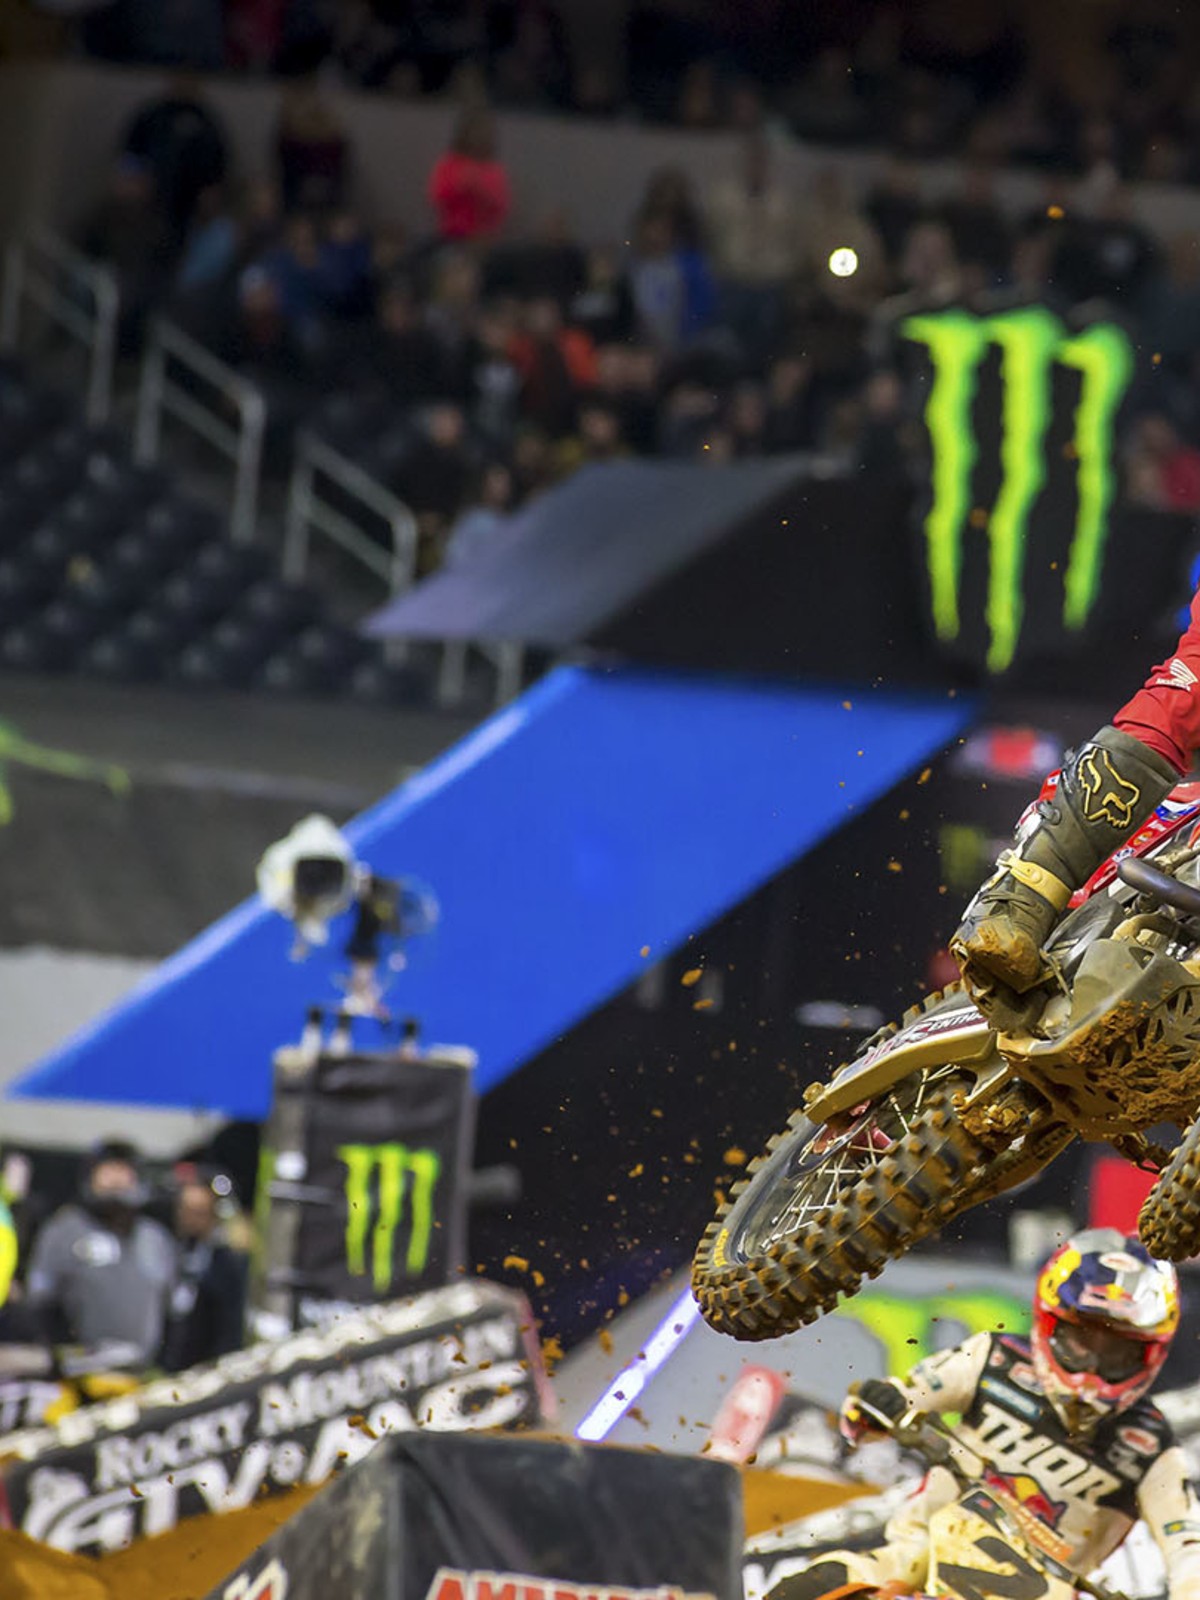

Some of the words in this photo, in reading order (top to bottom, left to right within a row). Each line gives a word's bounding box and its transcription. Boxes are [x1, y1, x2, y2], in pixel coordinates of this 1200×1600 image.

[96, 1401, 251, 1489] ROCKY
[257, 1313, 518, 1438] MOUNTAIN
[974, 1402, 1123, 1504] THOR
